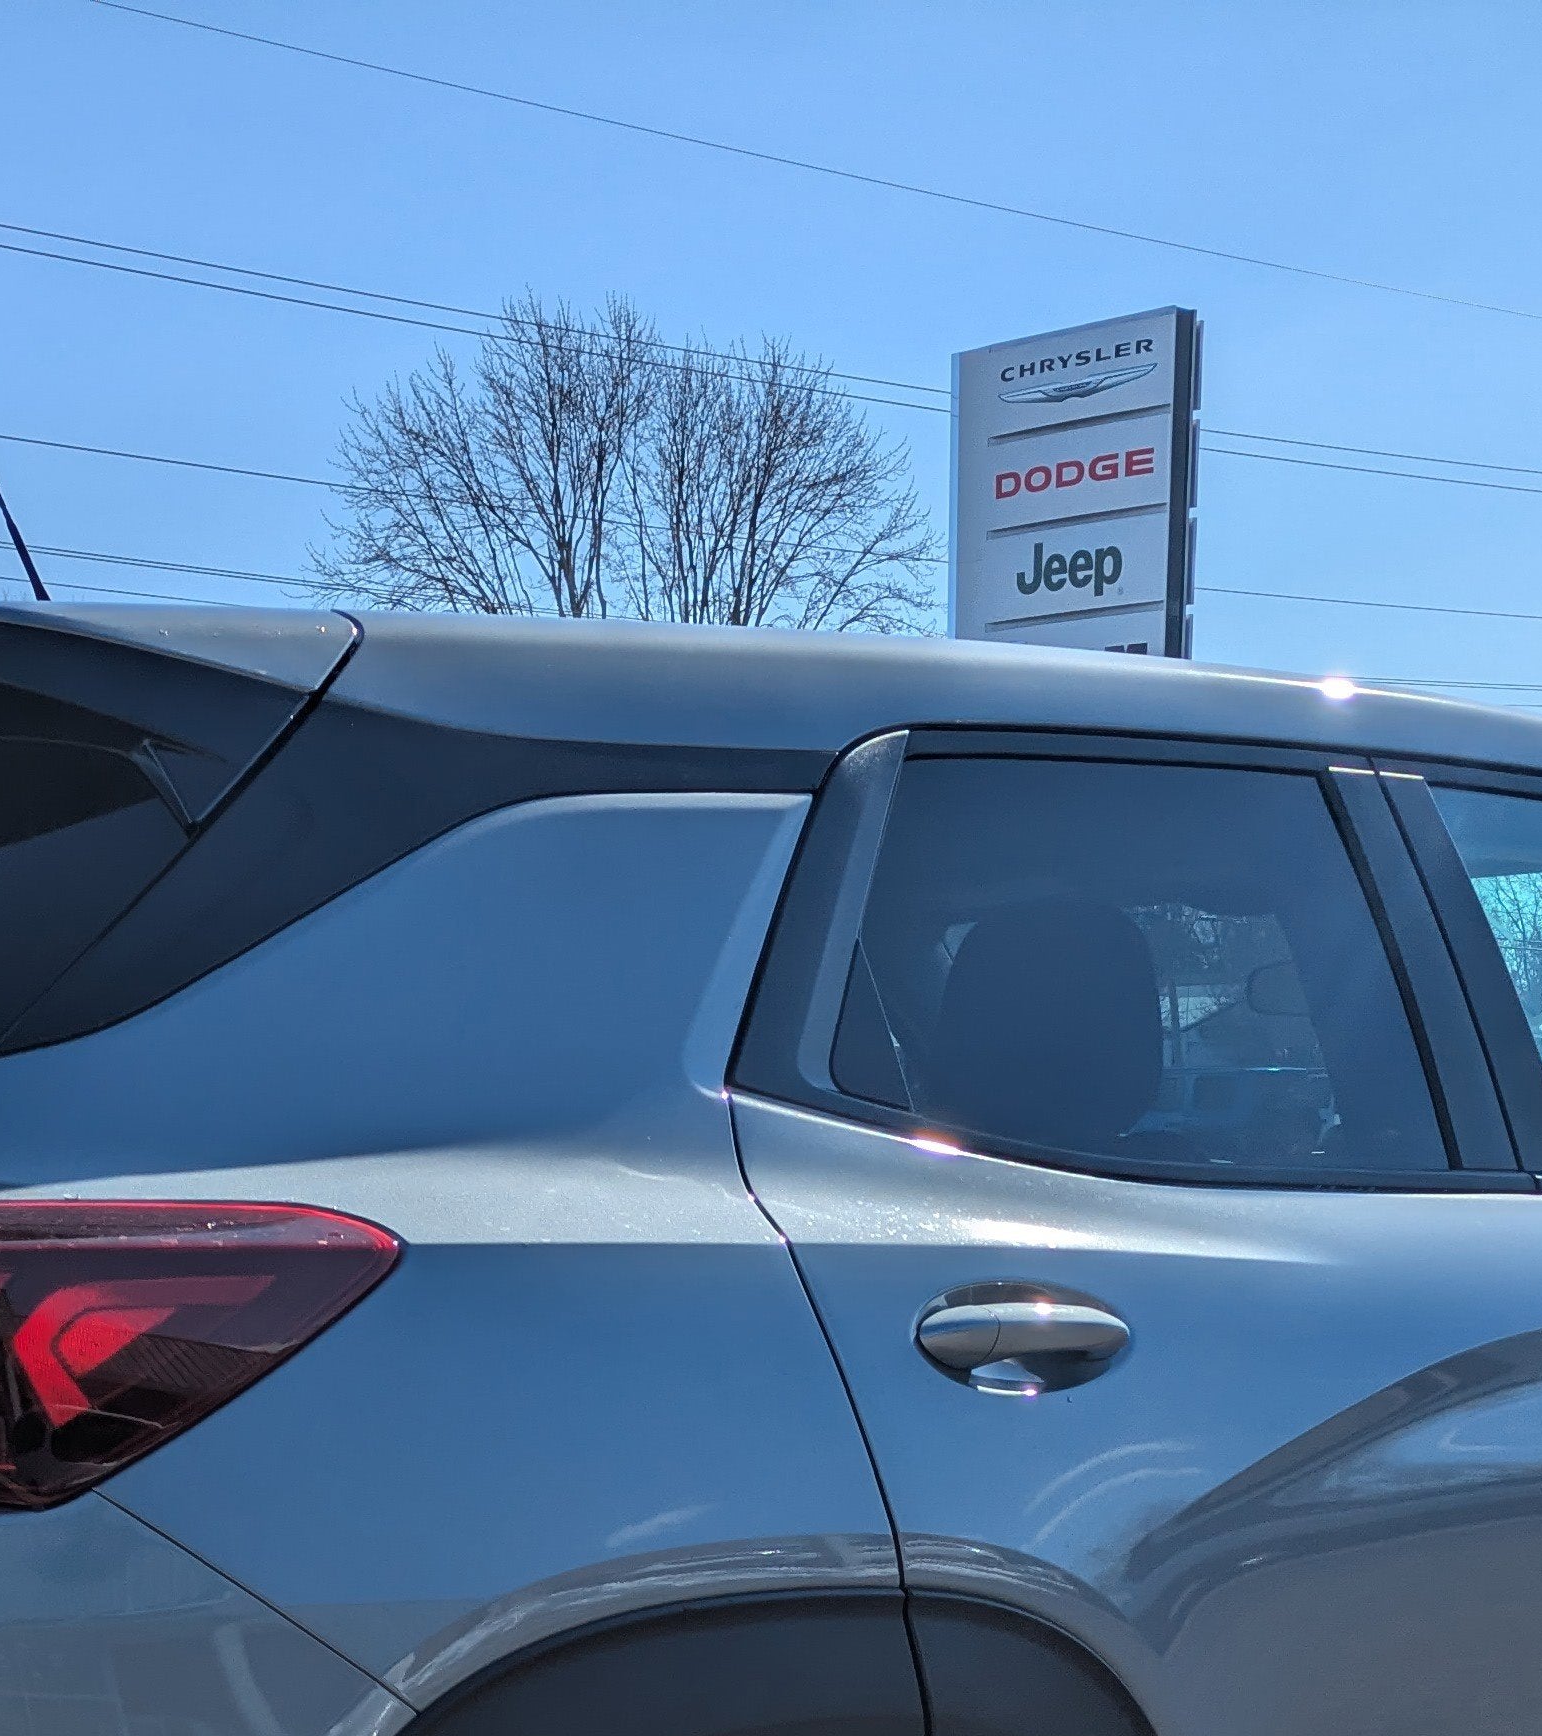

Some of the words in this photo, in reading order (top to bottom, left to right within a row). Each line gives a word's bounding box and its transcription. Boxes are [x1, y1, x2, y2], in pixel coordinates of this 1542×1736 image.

[1000, 338, 1154, 382] CHRYSLER
[995, 447, 1155, 500] DODGE
[1016, 542, 1123, 597] Jeep
